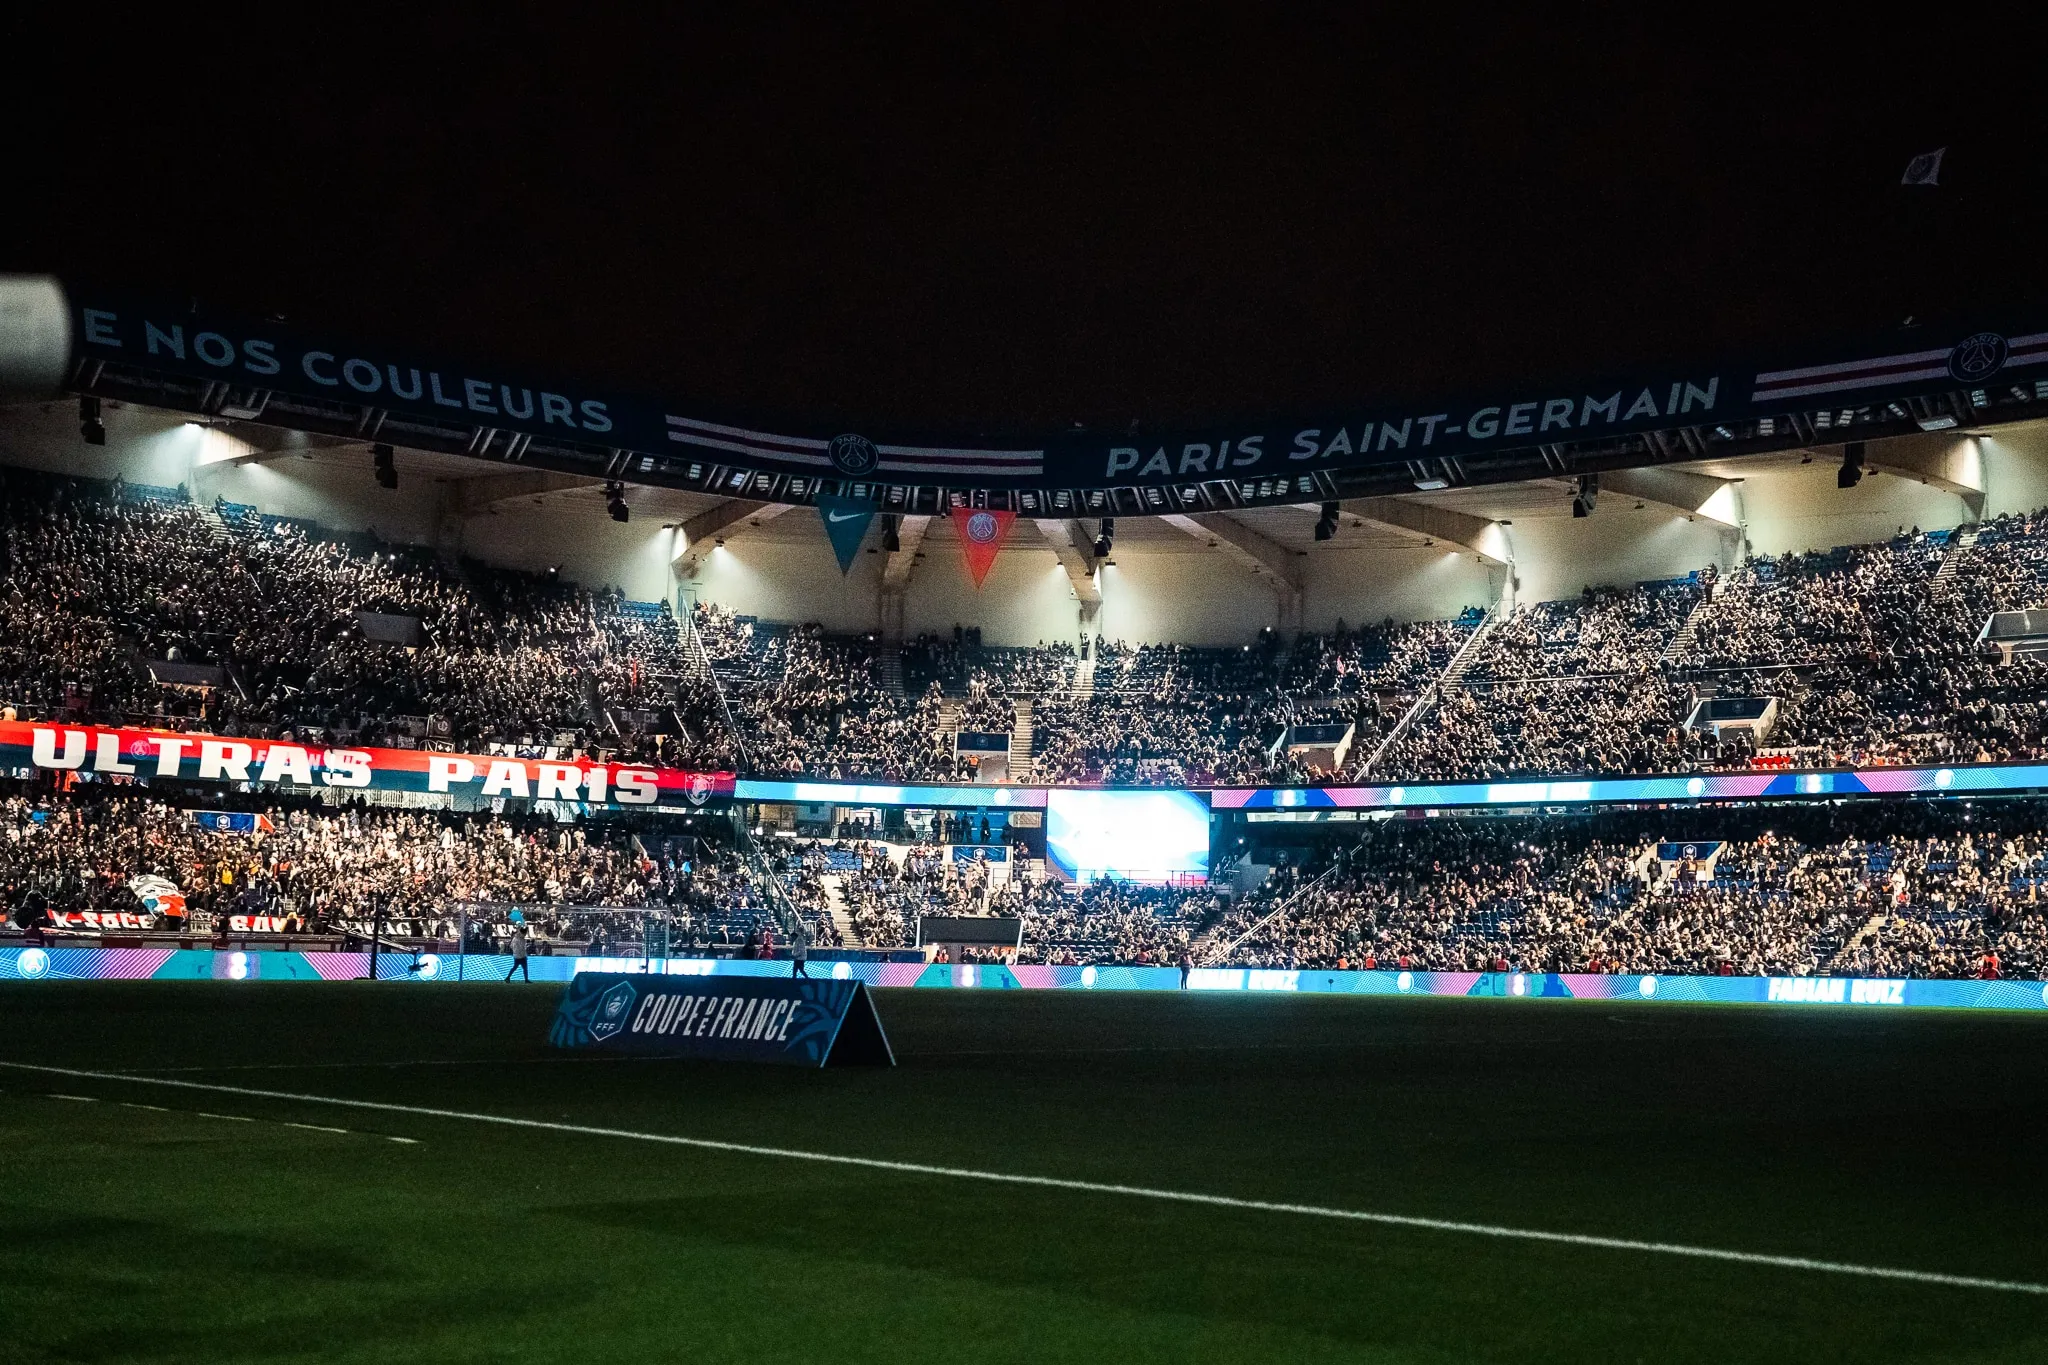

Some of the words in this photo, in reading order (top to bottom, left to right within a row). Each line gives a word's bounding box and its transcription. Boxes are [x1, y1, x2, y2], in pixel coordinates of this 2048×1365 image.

[144, 319, 281, 375] NOS
[301, 350, 613, 433] COULEURS
[1104, 435, 1265, 479] PARIS
[1288, 376, 1720, 462] SAINT-GERMAIN
[32, 727, 373, 788] ULTRAS
[429, 756, 659, 804] PARIS
[631, 993, 707, 1037] COUPE
[708, 996, 802, 1042] FRANCE
[1768, 976, 1846, 1002] FABIAN
[1850, 979, 1906, 1004] RUIZ
[595, 1022, 616, 1032] FFF
